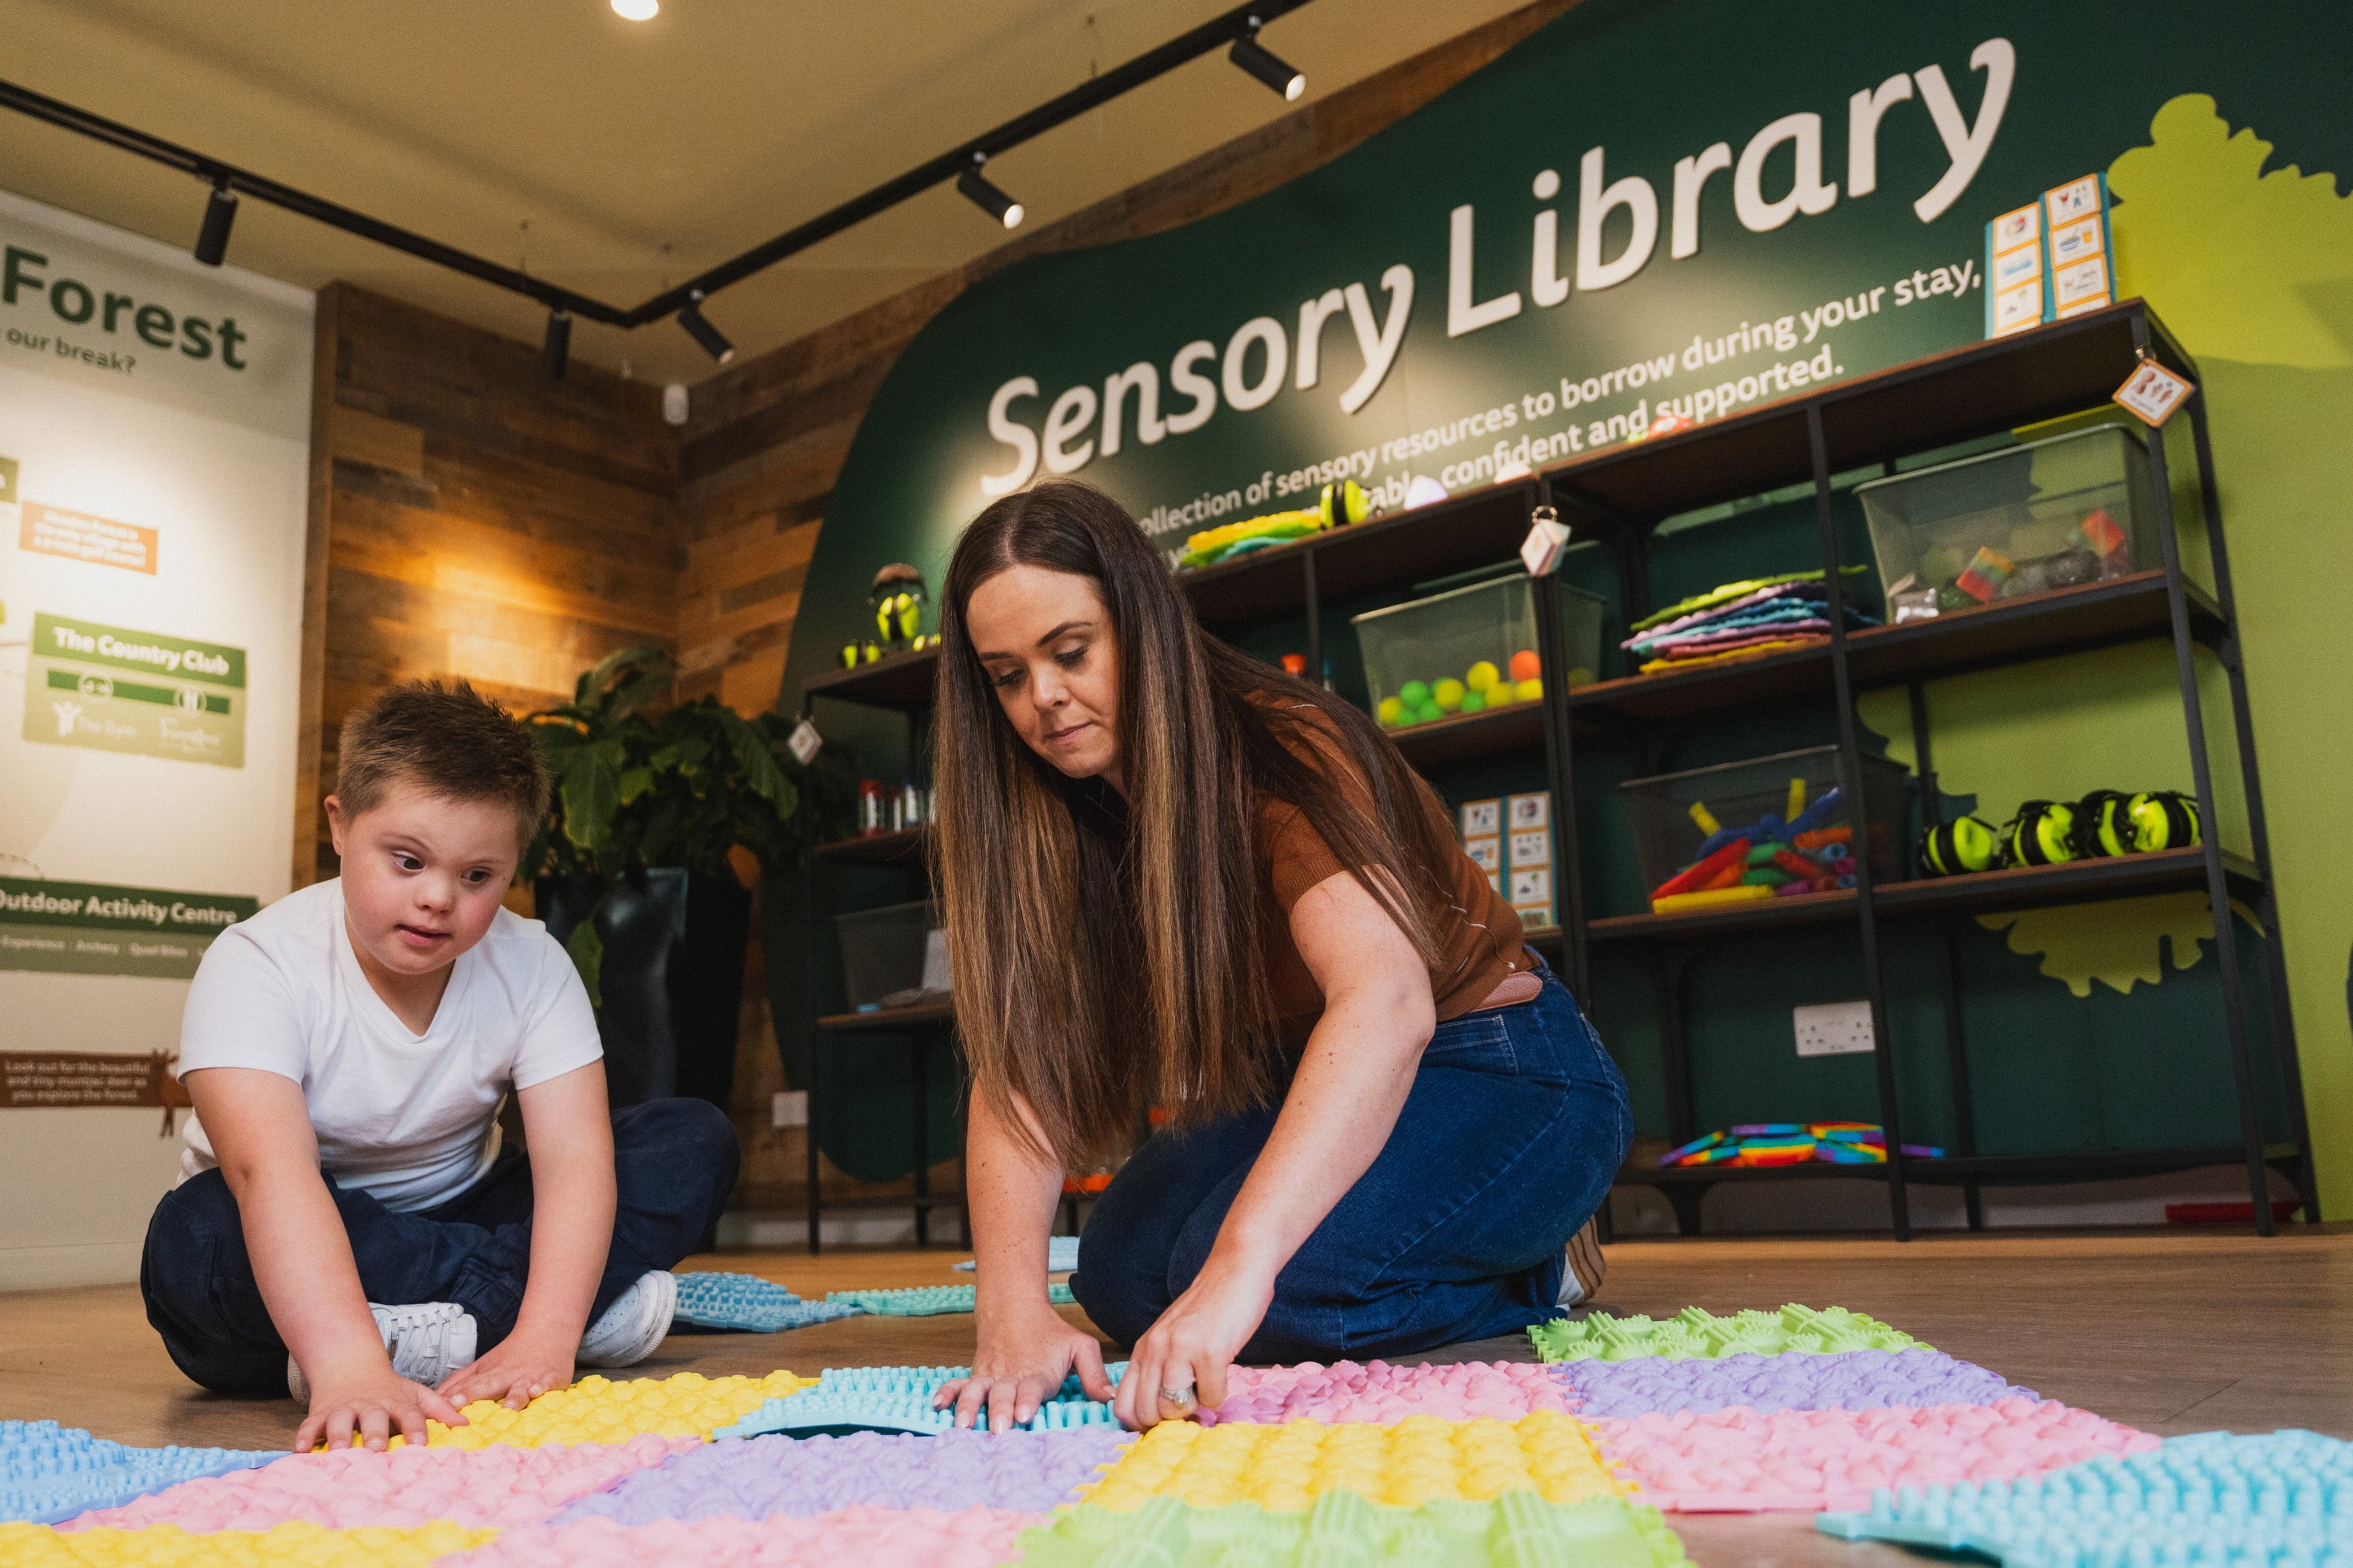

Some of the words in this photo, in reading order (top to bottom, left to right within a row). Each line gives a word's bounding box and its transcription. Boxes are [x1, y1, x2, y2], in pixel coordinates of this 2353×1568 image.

[1, 243, 247, 371] Forest
[980, 263, 1415, 496] Sensory
[1448, 37, 2016, 338] Library
[55, 334, 136, 375] break?
[1139, 489, 1242, 536] ollection
[1245, 470, 1274, 506] of
[1275, 448, 1377, 498] sensory
[1381, 403, 1518, 464] resources
[1522, 392, 1556, 421] to
[1560, 352, 1677, 409] borrow
[1682, 321, 1799, 371] during
[1800, 285, 1887, 344] your
[1893, 258, 1982, 306] stay,
[1441, 424, 1584, 489] confident
[1588, 398, 1649, 446] and
[1655, 343, 1845, 423] supported.
[52, 626, 95, 653] The
[97, 635, 182, 672] Country
[182, 649, 229, 676] Club
[84, 895, 168, 926] Activity
[169, 901, 238, 925] Centre
